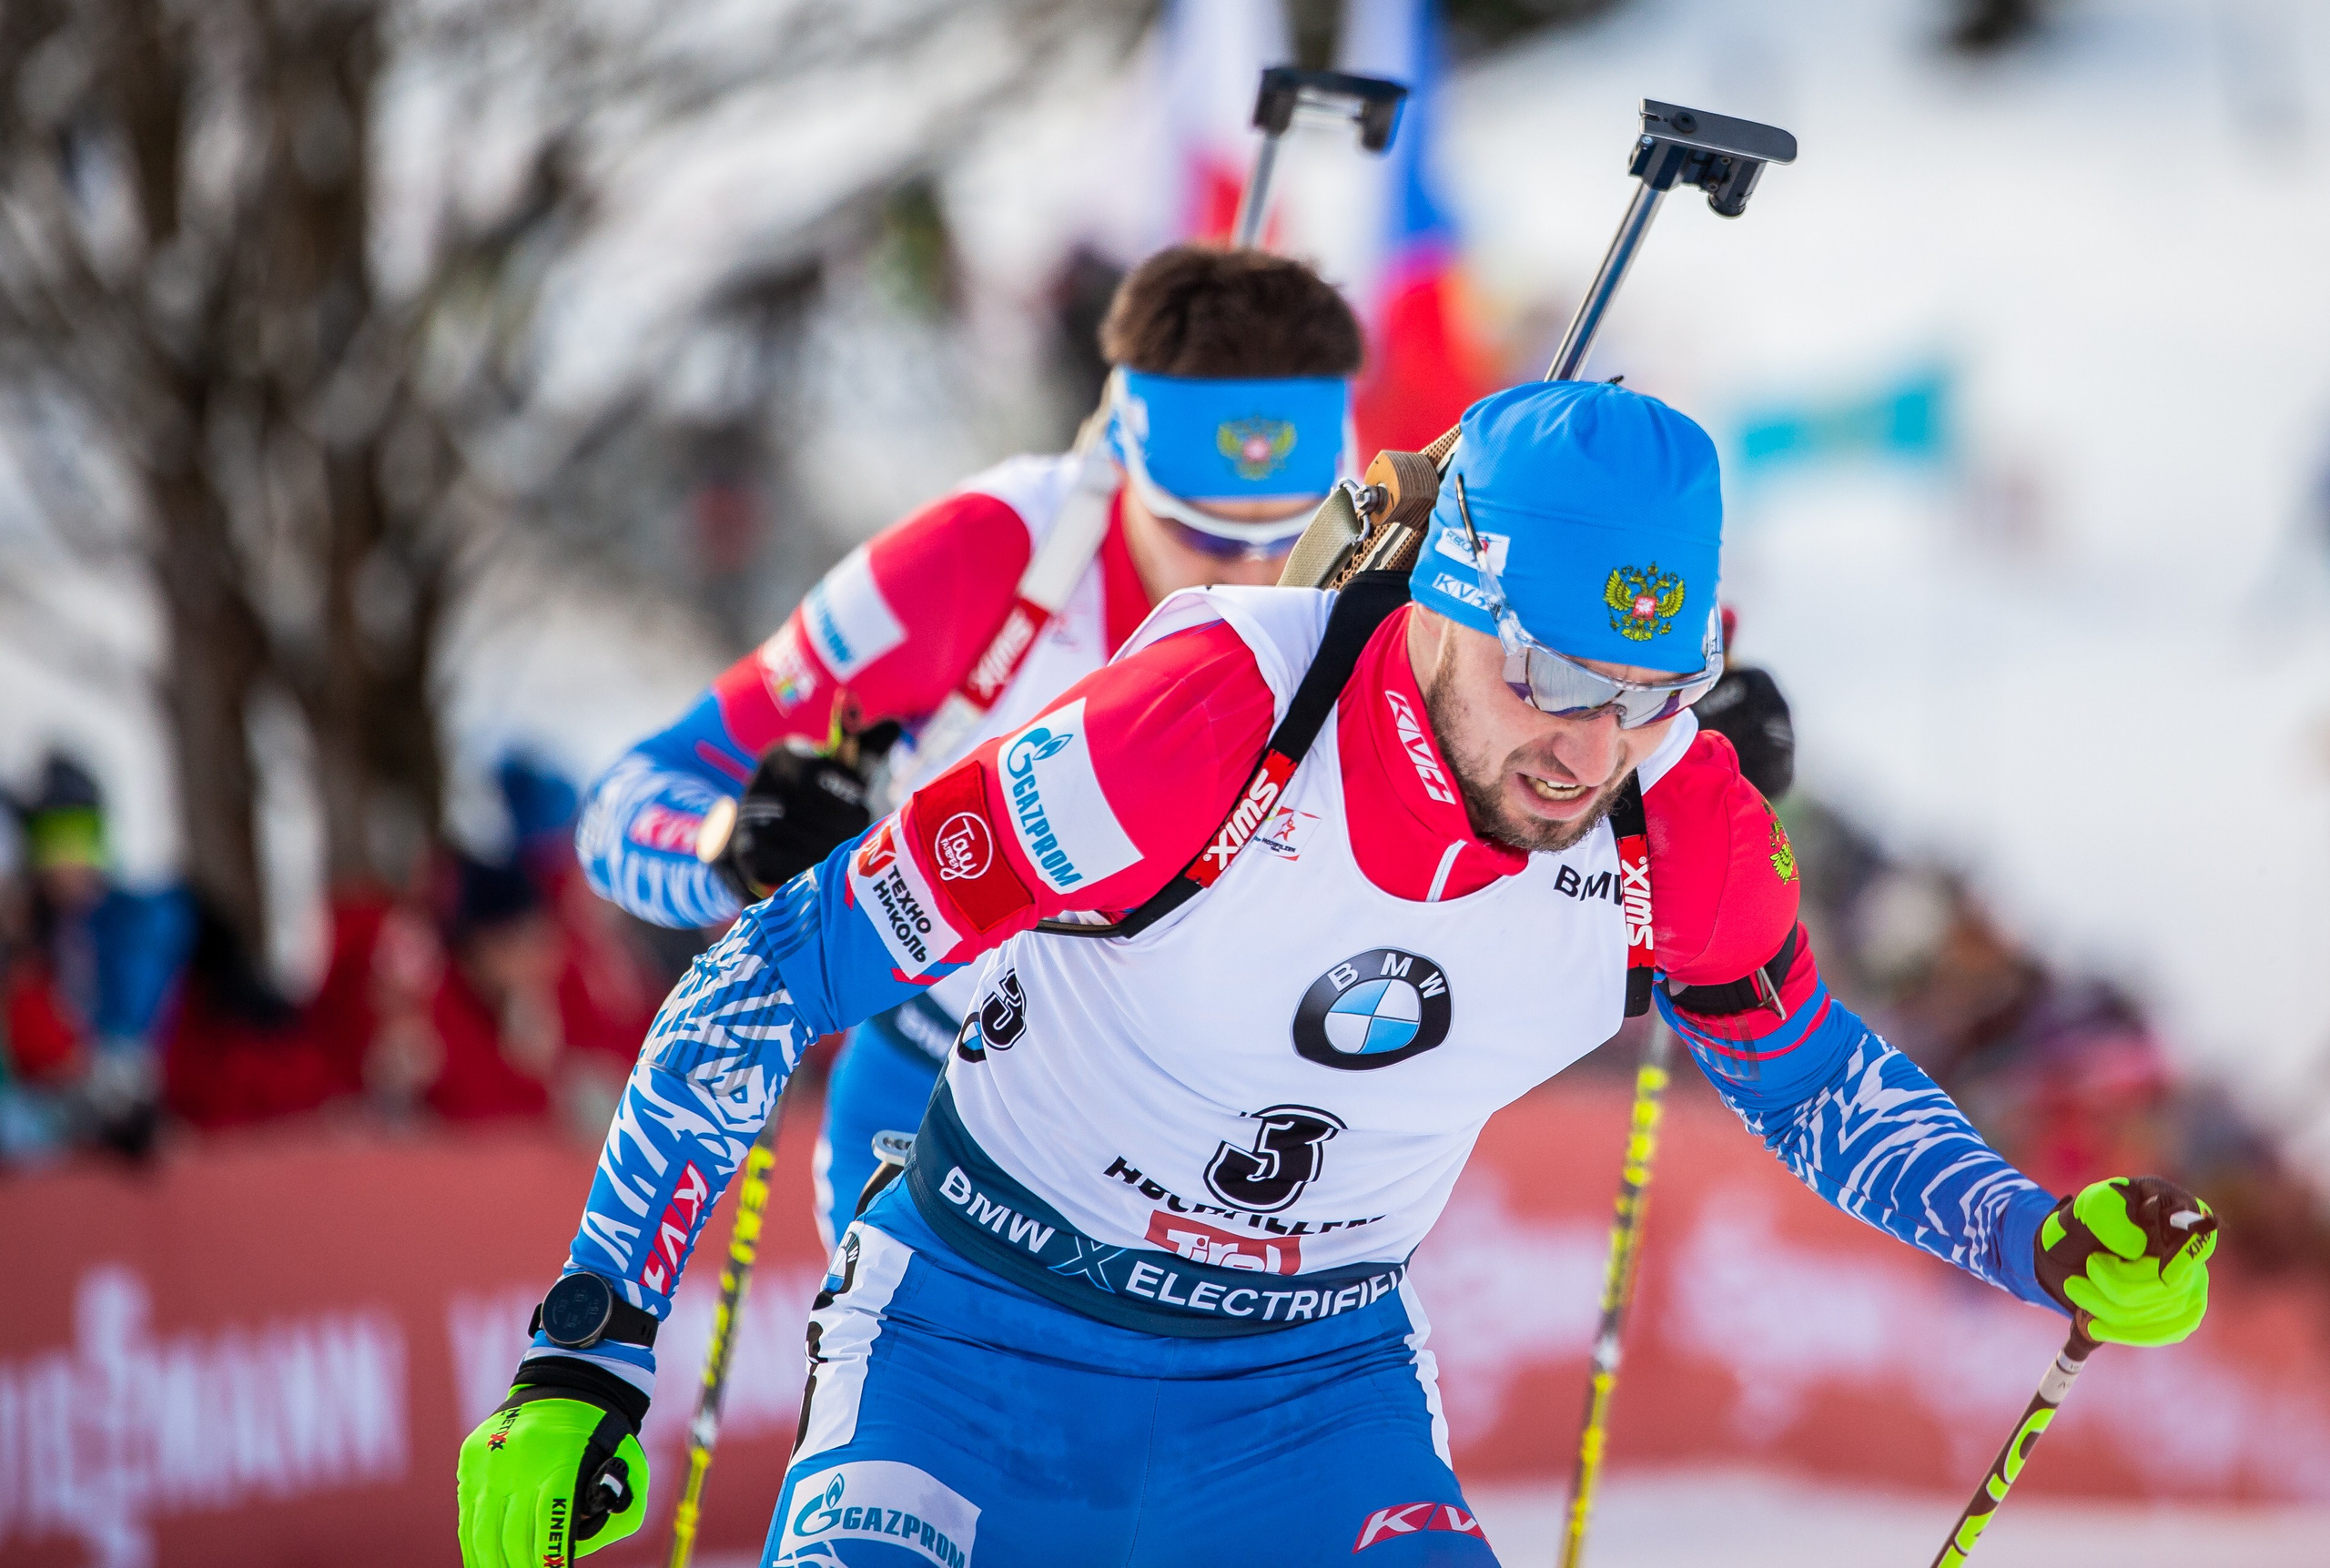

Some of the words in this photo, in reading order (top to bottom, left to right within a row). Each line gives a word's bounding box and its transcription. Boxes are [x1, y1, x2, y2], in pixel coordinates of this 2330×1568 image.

[1011, 777, 1084, 887] GAZPROM
[872, 878, 927, 963] НИКОЛЬ
[887, 865, 932, 935] ТЕХНО
[1326, 952, 1446, 1000] BMW
[1202, 1103, 1349, 1214] 3
[938, 1165, 1056, 1255] BMW
[842, 1506, 966, 1568] GAZPROM
[1354, 1502, 1483, 1553] KV
